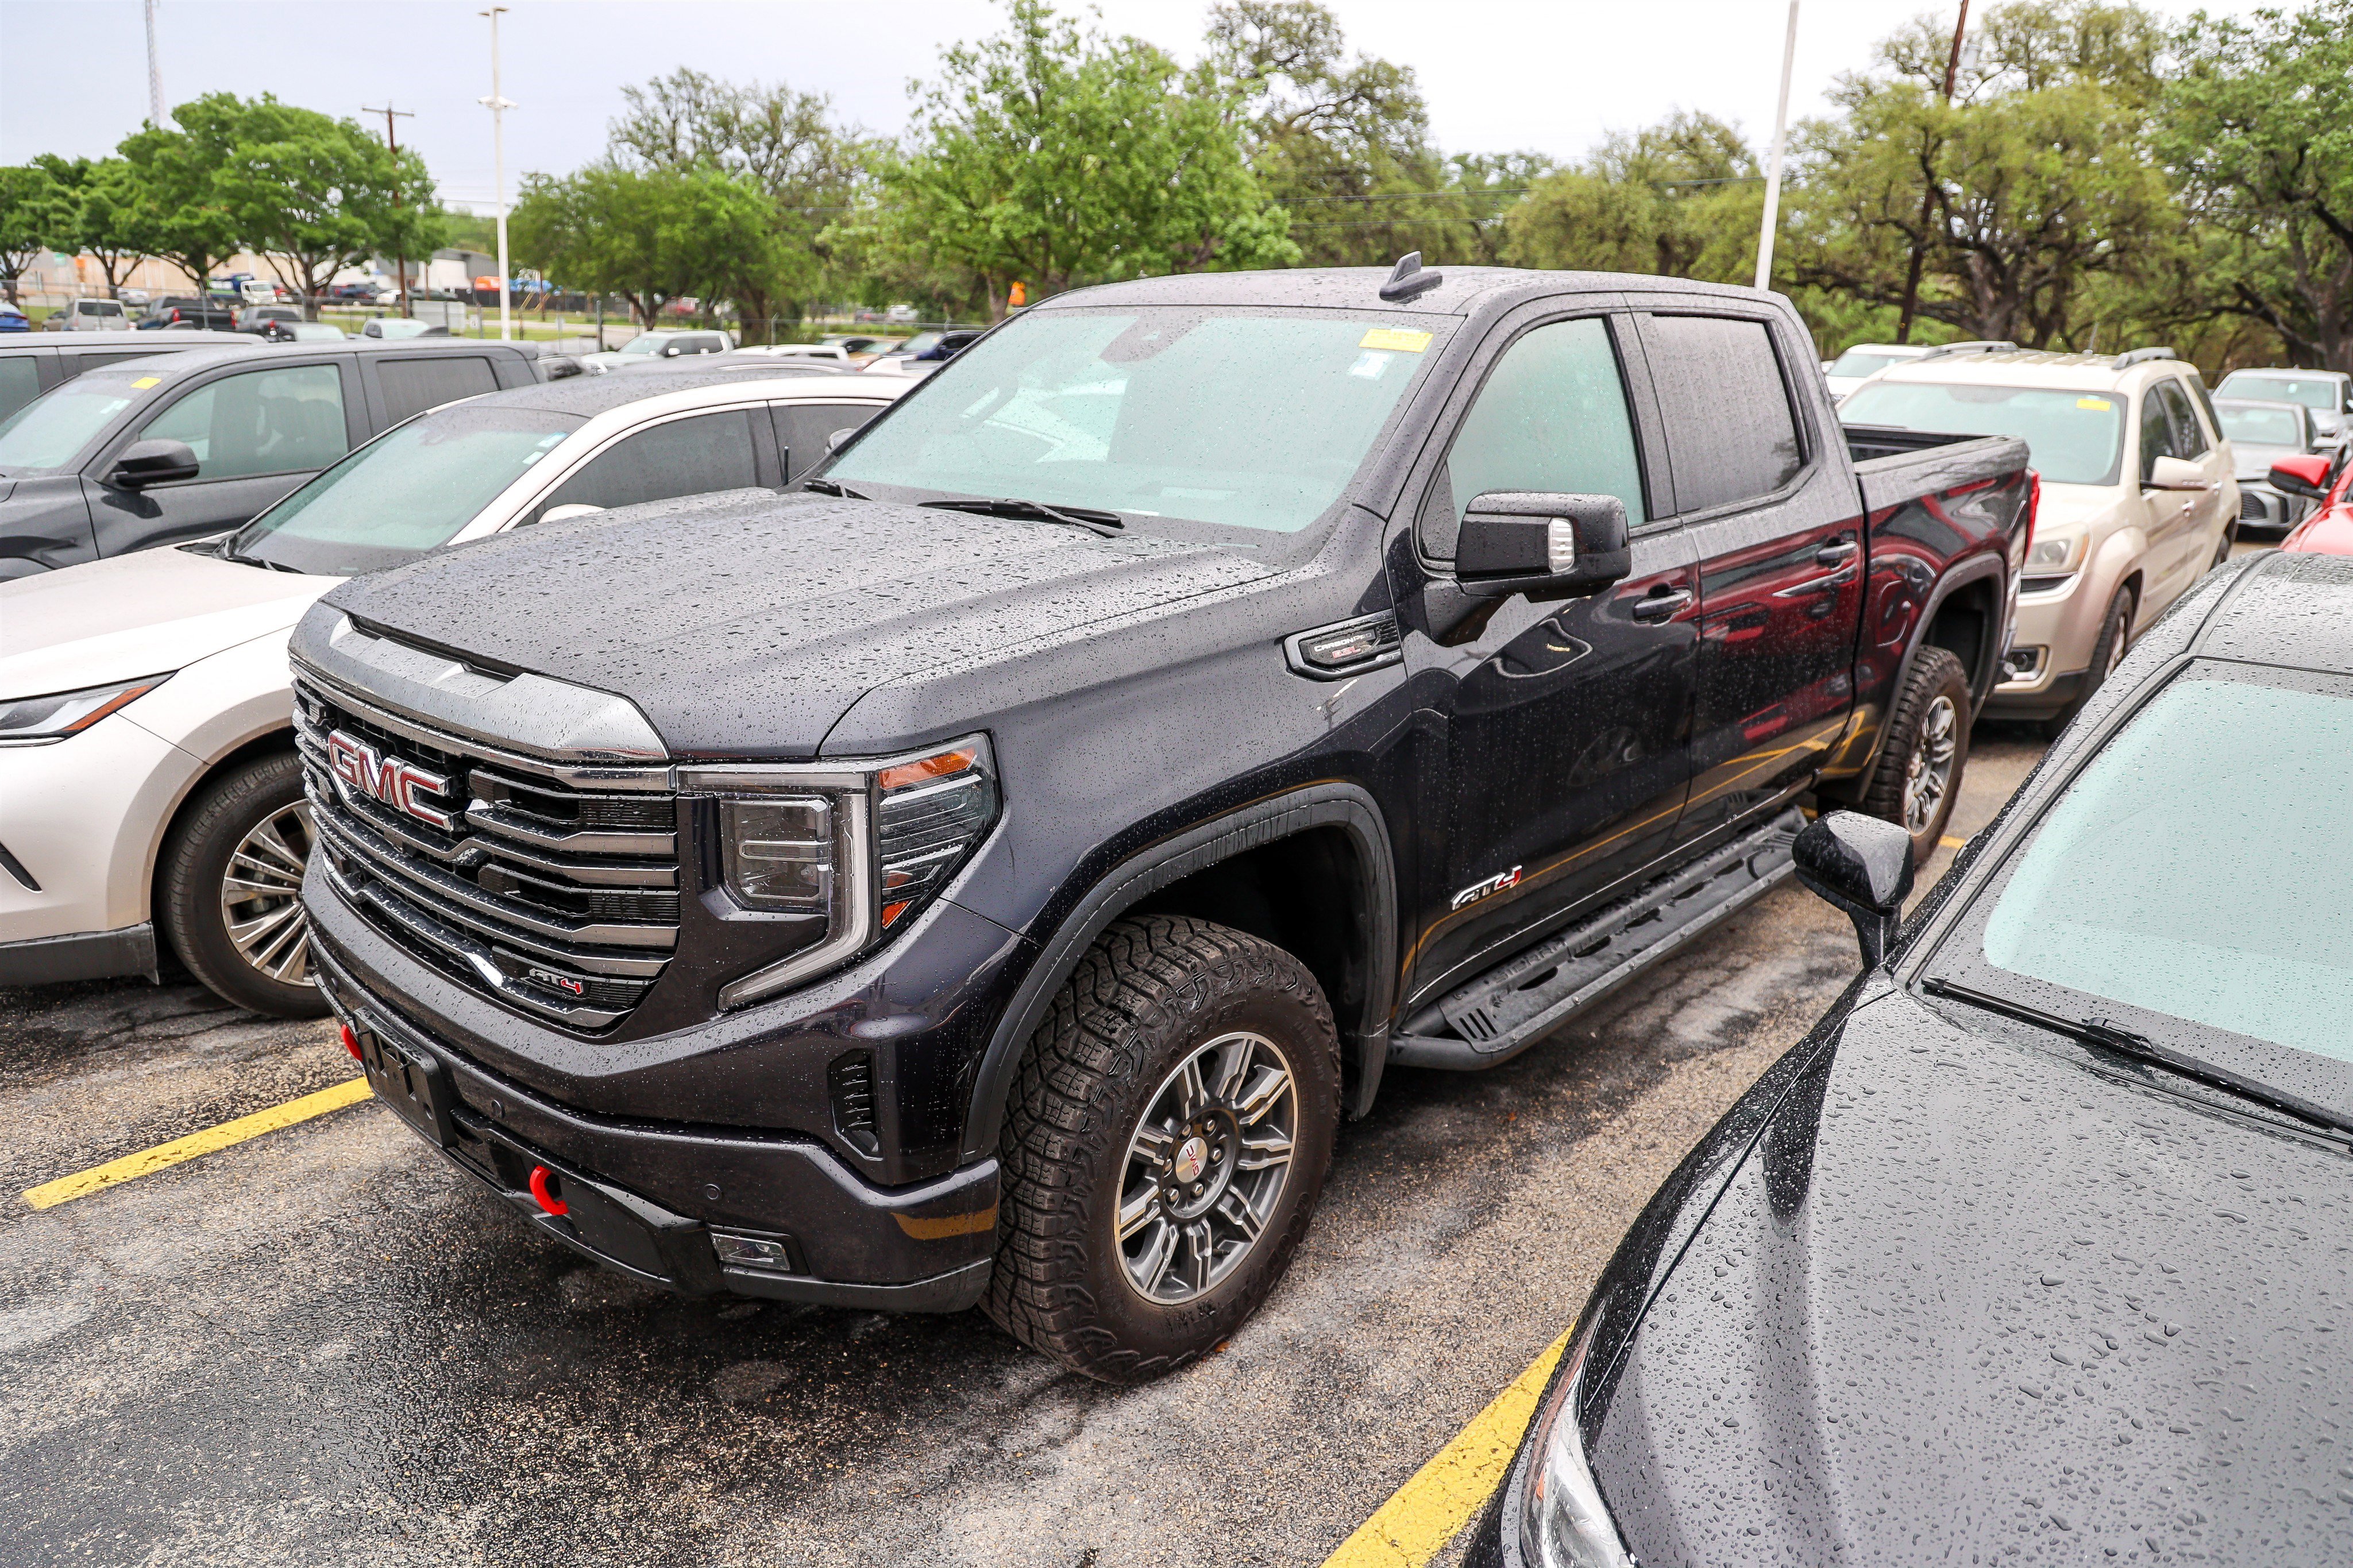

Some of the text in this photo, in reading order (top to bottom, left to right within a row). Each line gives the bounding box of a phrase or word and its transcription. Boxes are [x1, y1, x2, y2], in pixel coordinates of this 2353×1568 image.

[329, 728, 454, 831] GMC
[1451, 865, 1522, 910] AT4
[529, 968, 583, 994] AT4
[1186, 1144, 1199, 1176] GMC
